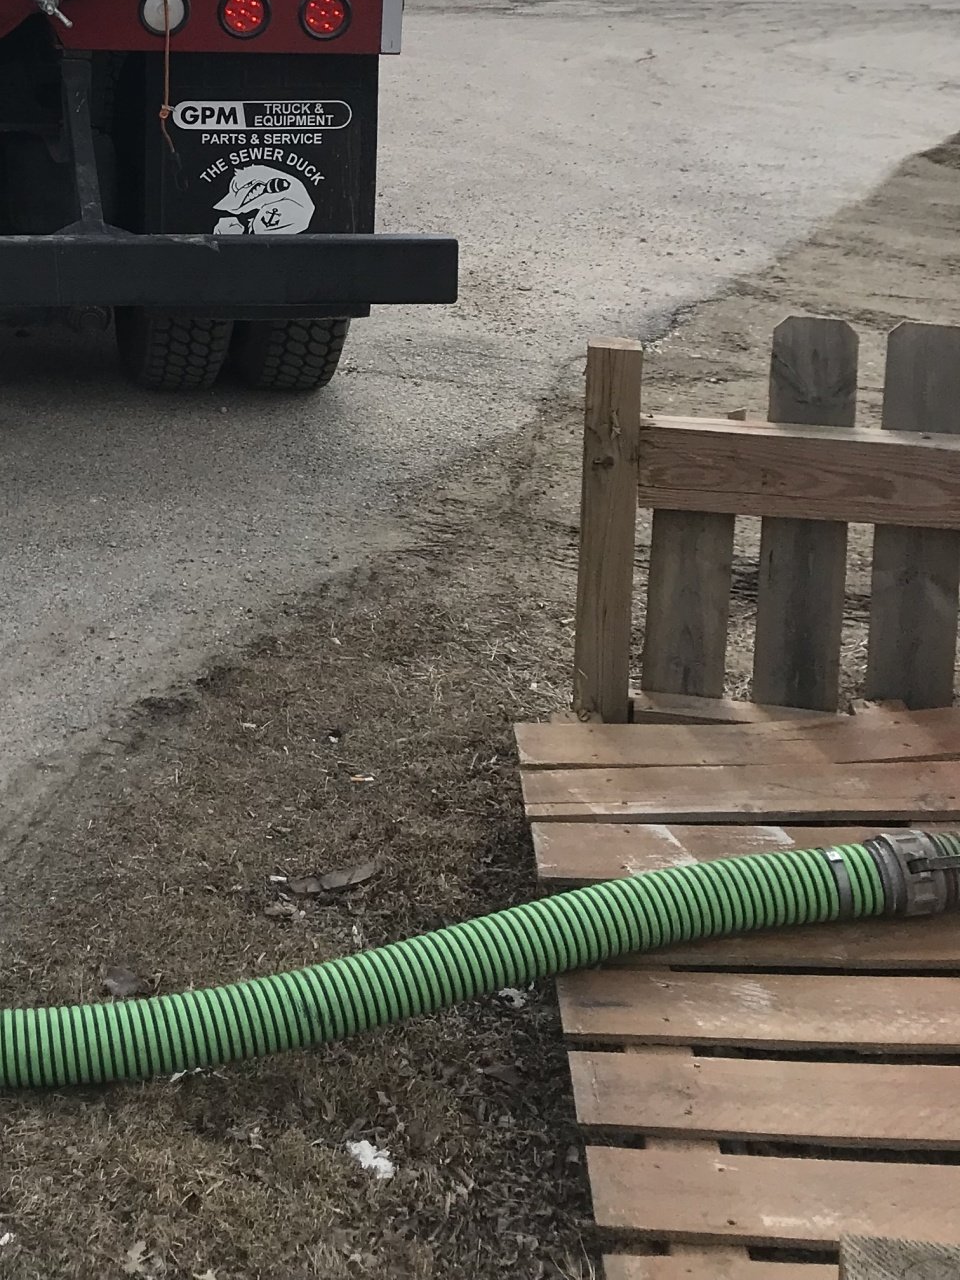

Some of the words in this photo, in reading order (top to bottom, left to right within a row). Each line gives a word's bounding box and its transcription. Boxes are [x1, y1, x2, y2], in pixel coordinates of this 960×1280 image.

[180, 106, 239, 125] GPM
[264, 103, 310, 114] TRUCK
[314, 103, 324, 114] &
[254, 114, 334, 126] EQUIPMENT
[201, 133, 247, 145] PARTS
[250, 133, 260, 145] &
[263, 133, 323, 145] SERVICE
[199, 158, 229, 184] THE
[229, 147, 284, 165] SEWER
[286, 152, 326, 186] DUCK
